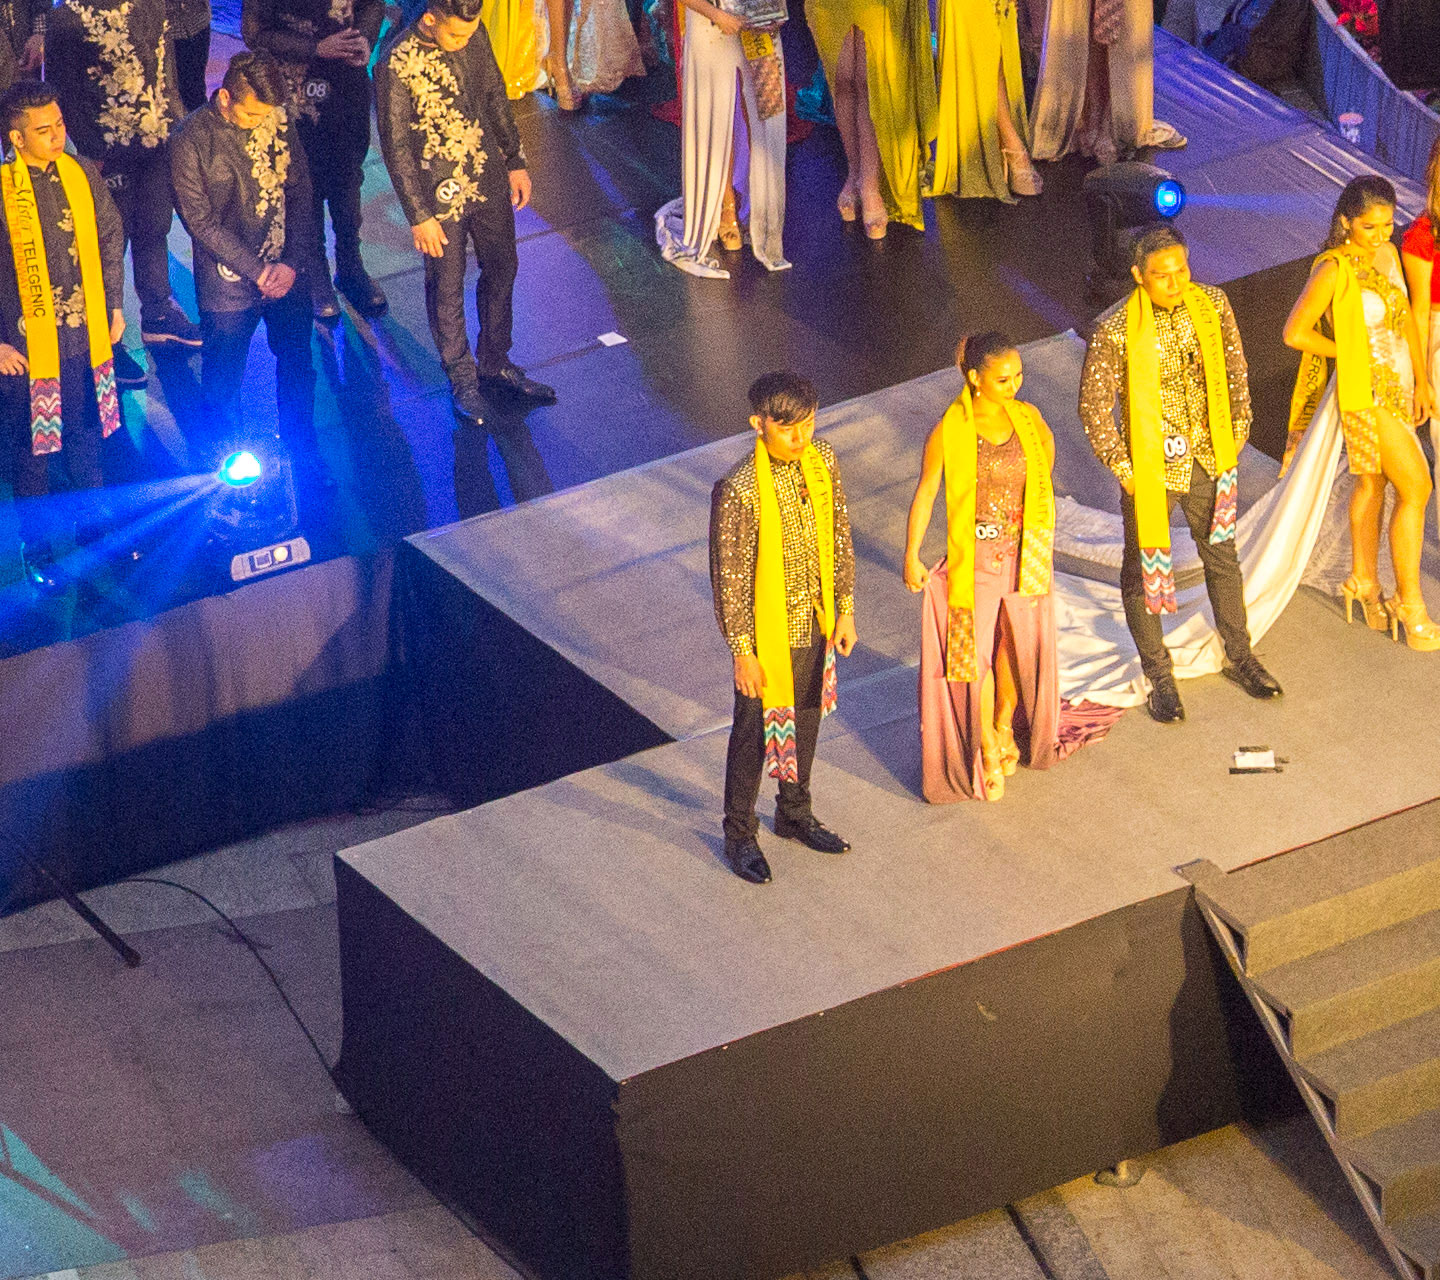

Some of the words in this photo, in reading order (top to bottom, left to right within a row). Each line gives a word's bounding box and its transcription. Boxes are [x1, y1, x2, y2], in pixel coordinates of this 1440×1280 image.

[306, 82, 326, 98] 08
[439, 181, 460, 200] 04
[21, 239, 47, 318] TELEGENIC
[1163, 437, 1187, 458] 09
[975, 524, 999, 539] 05
